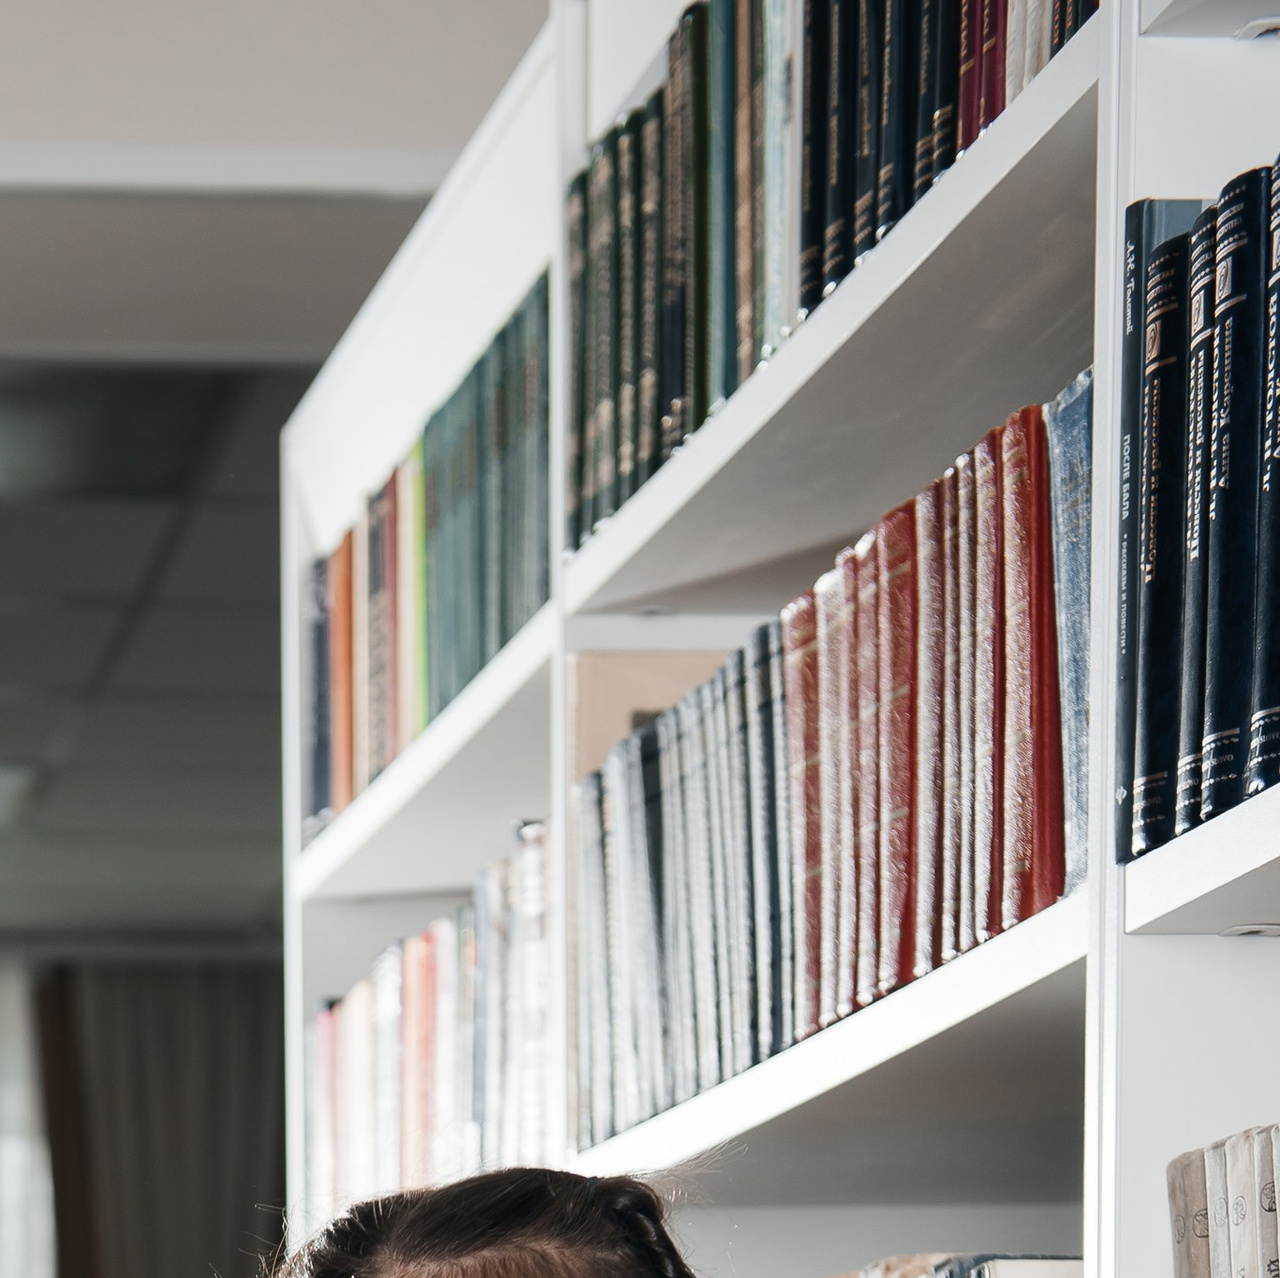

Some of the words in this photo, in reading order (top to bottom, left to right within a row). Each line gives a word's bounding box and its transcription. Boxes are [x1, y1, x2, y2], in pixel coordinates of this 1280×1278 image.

[1219, 316, 1234, 429] Каренина
[1122, 434, 1131, 481] ПОСЛЕ
[1218, 433, 1231, 490] Анна
[1122, 483, 1131, 521] БАЛА
